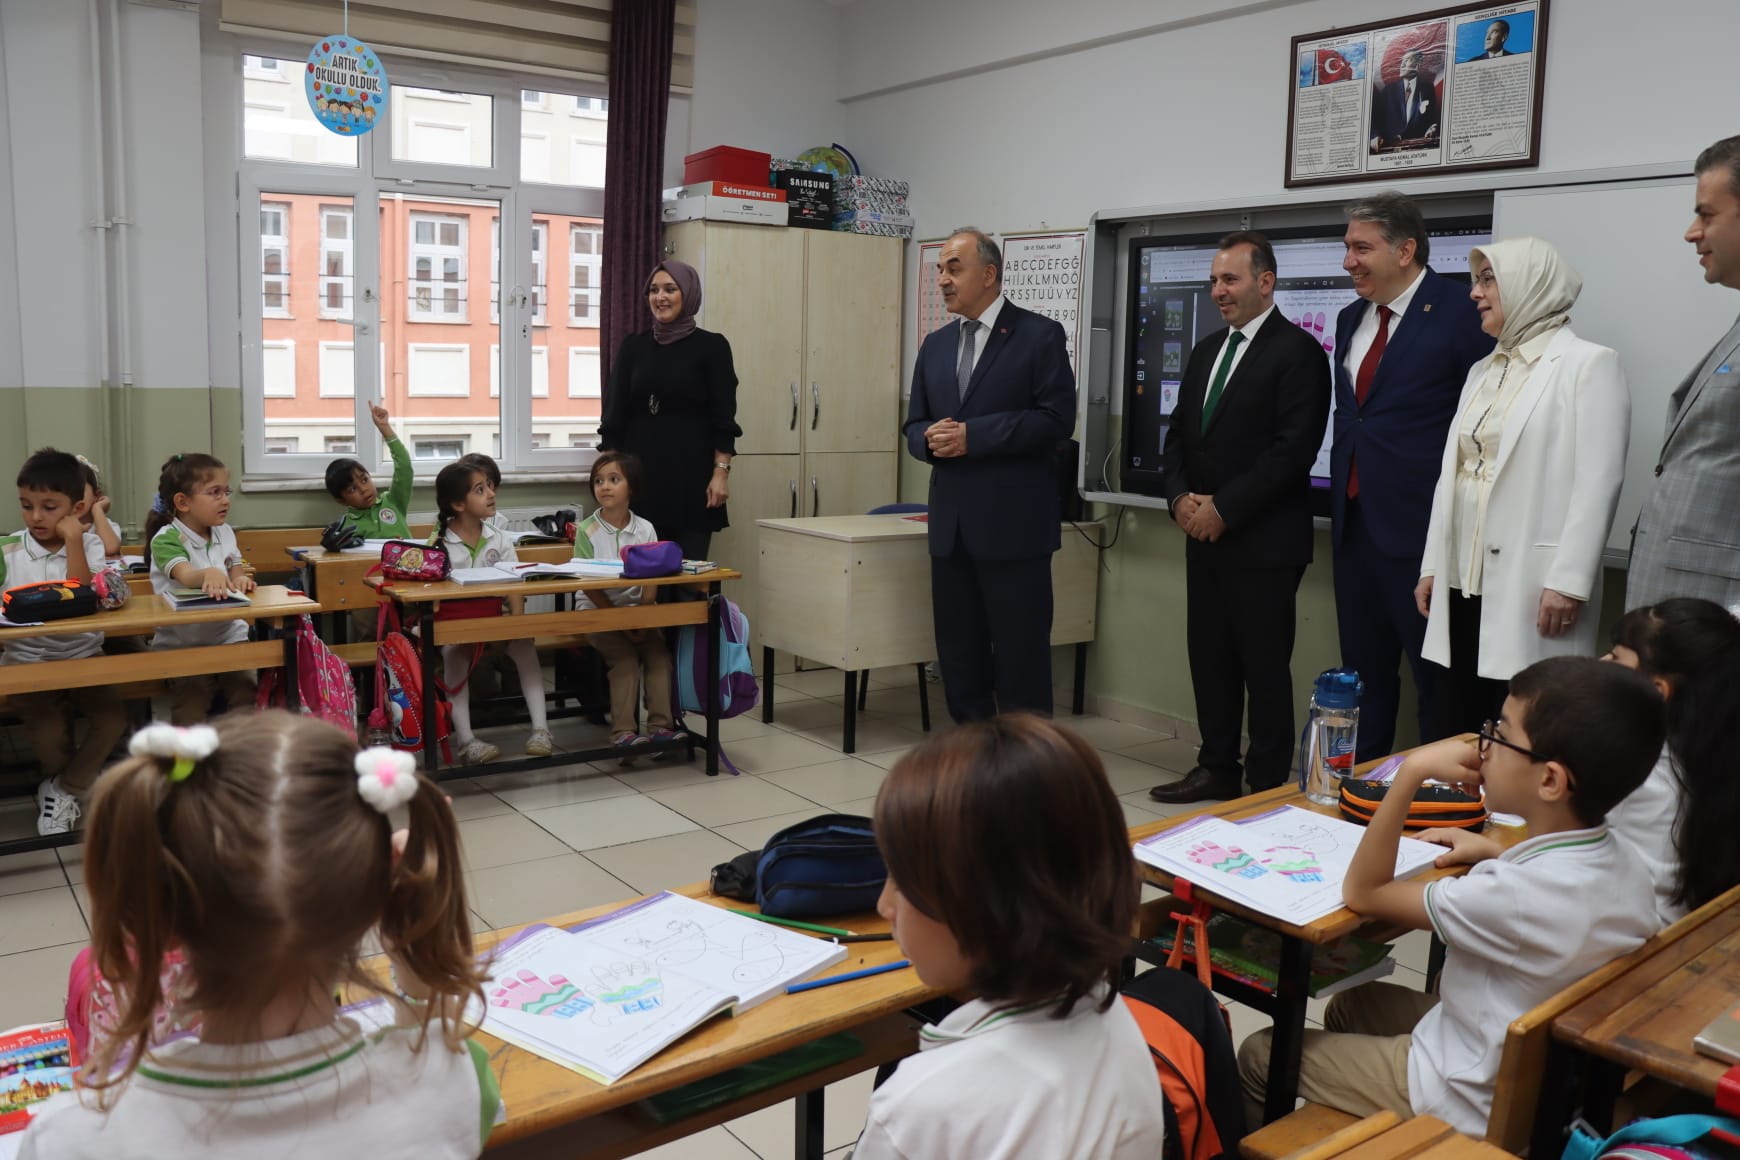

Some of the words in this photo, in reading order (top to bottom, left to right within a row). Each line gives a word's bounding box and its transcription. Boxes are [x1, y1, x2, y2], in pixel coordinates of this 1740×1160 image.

[332, 55, 358, 72] ARTIK
[315, 66, 347, 85] OKULLU
[349, 74, 381, 92] OLDUK.
[789, 177, 830, 190] SAMSUNG
[722, 185, 761, 198] ÖĞRETMEN
